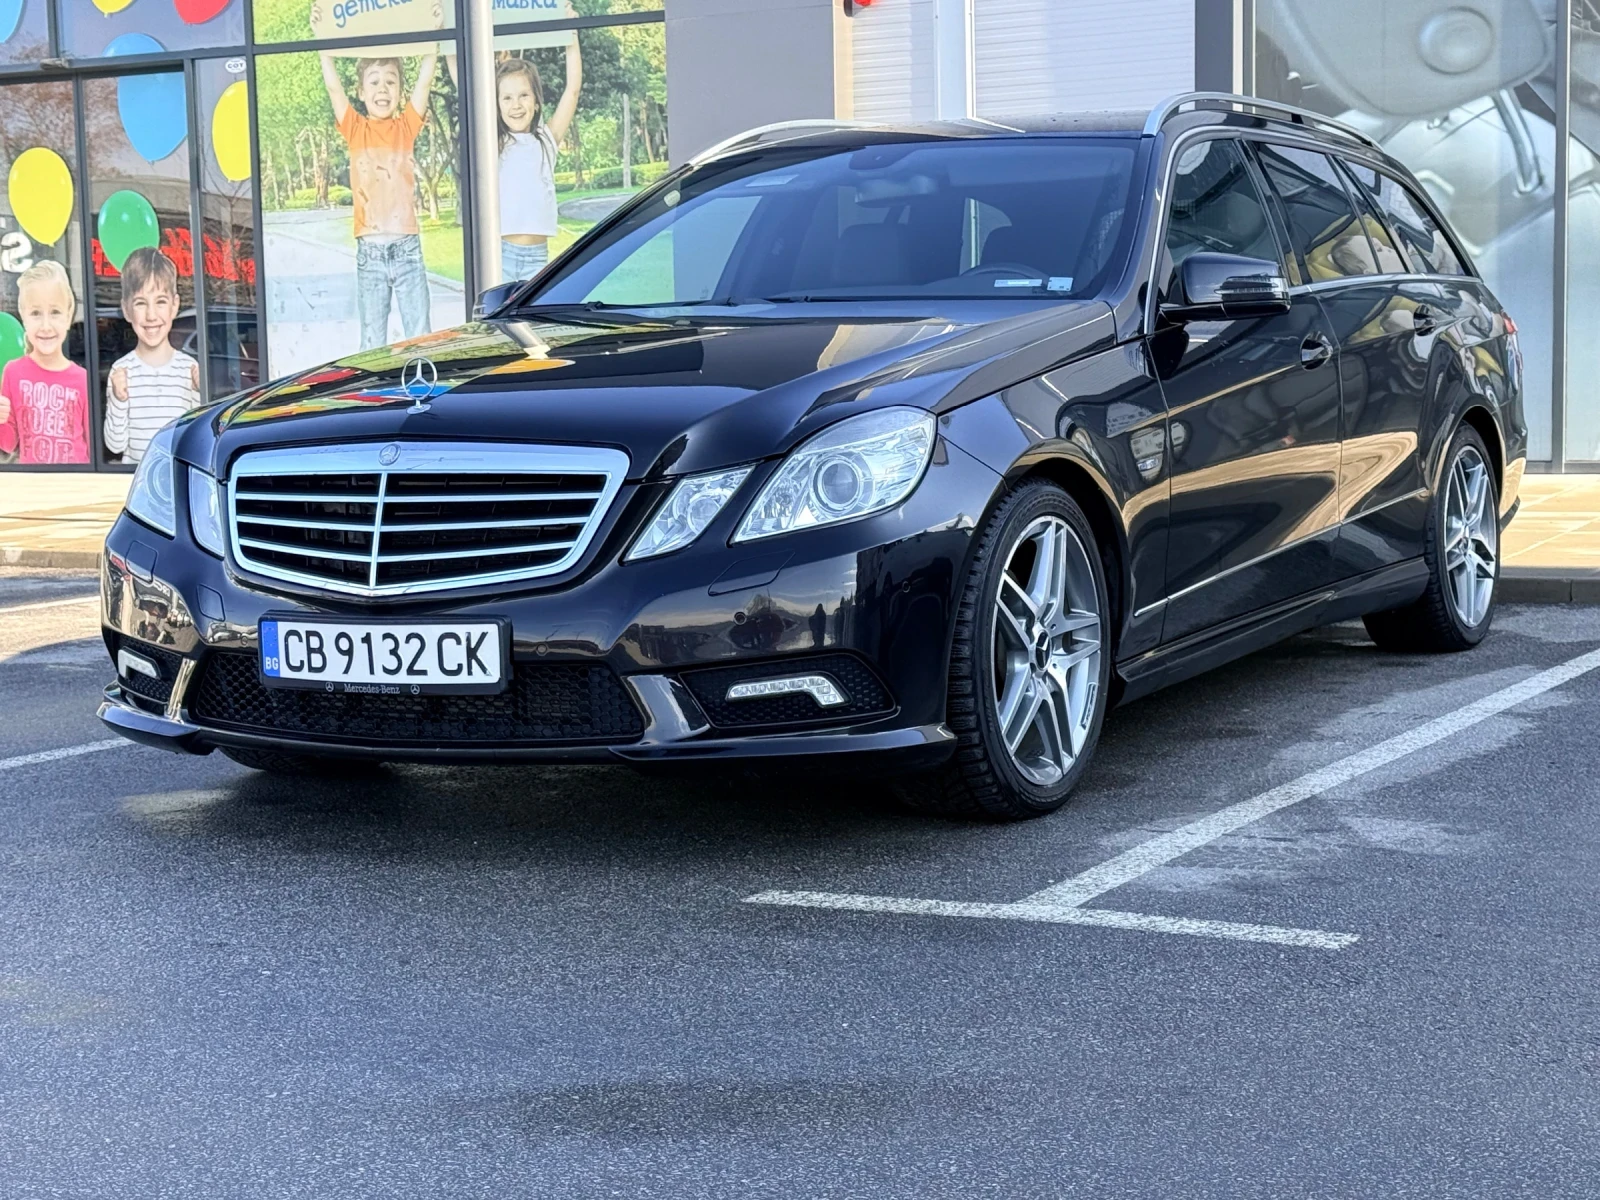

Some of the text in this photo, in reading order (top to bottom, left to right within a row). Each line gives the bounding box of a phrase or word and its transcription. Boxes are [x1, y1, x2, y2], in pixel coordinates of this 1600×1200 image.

[333, 0, 413, 28] детс
[265, 656, 279, 670] BG
[284, 629, 492, 677] CB 9132 CK
[343, 683, 401, 694] Mercedes-Benz
